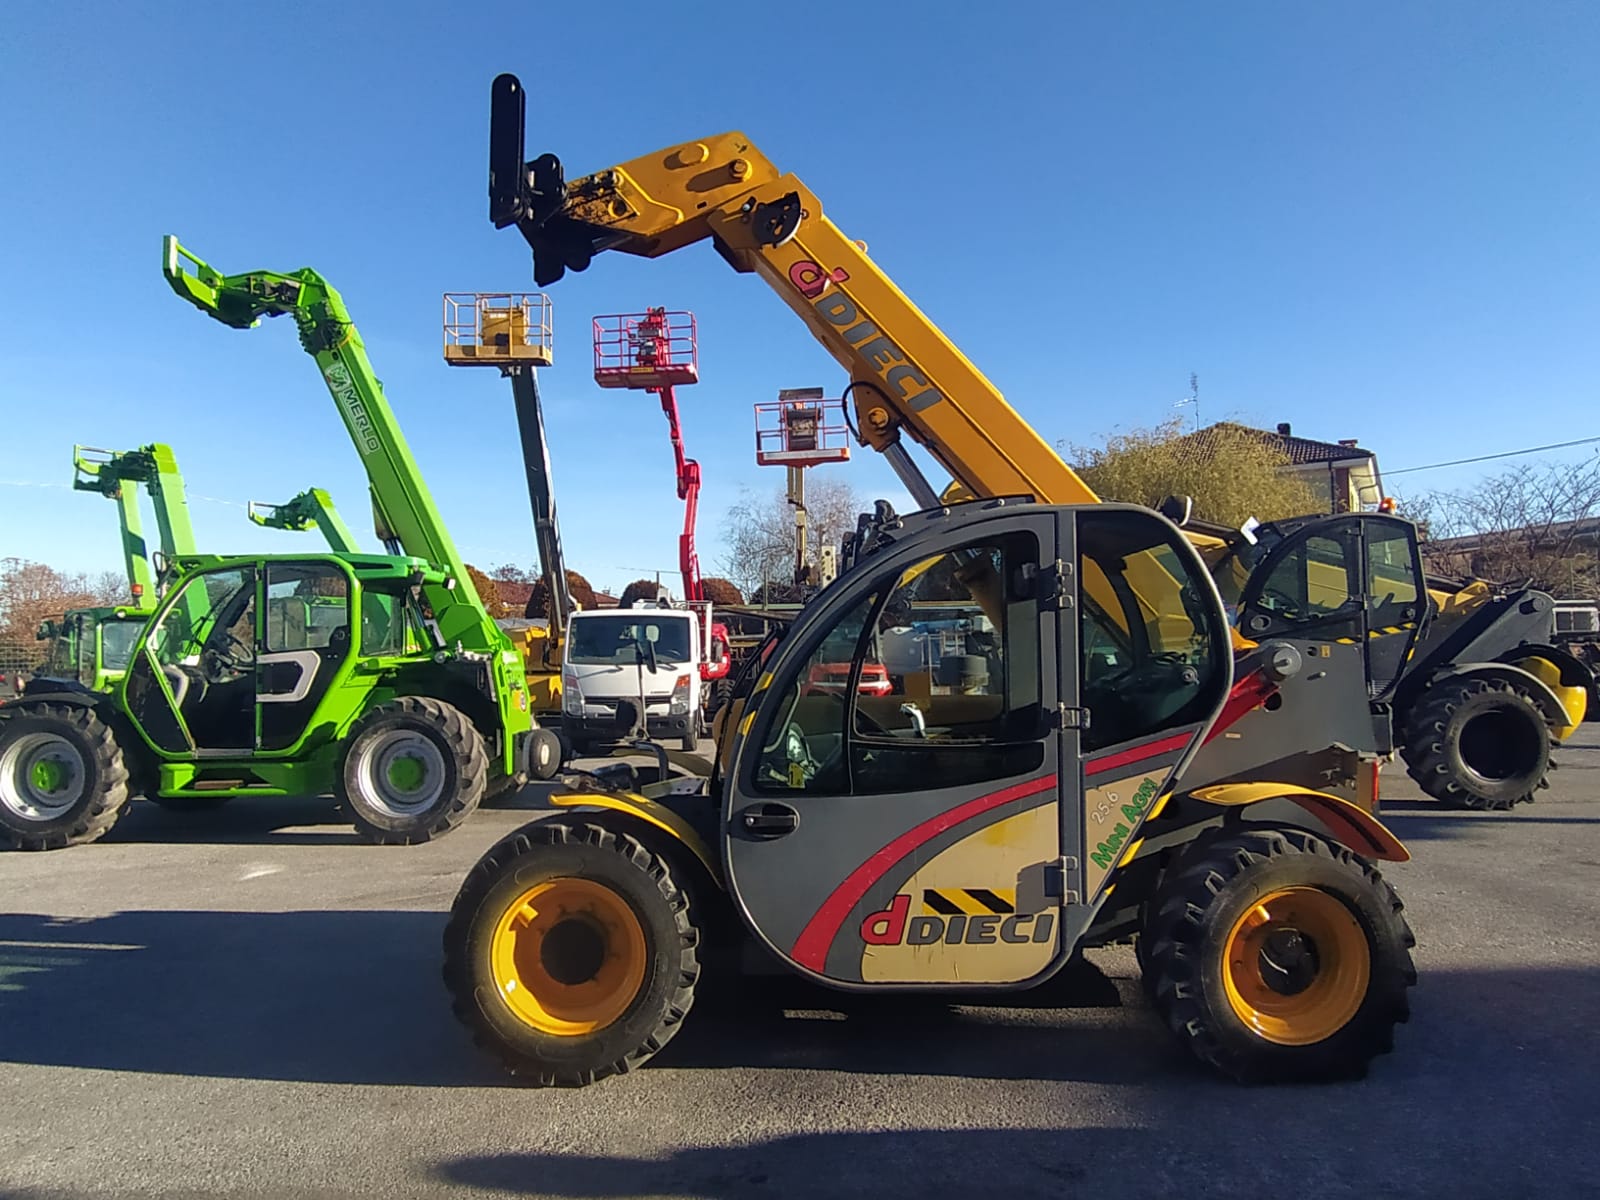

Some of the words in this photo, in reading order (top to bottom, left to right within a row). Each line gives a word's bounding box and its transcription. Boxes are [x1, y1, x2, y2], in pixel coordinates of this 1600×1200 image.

[814, 291, 944, 413] DIECI
[343, 388, 379, 451] MERLO
[1091, 790, 1120, 825] 25.6
[906, 913, 1055, 946] DIECI
